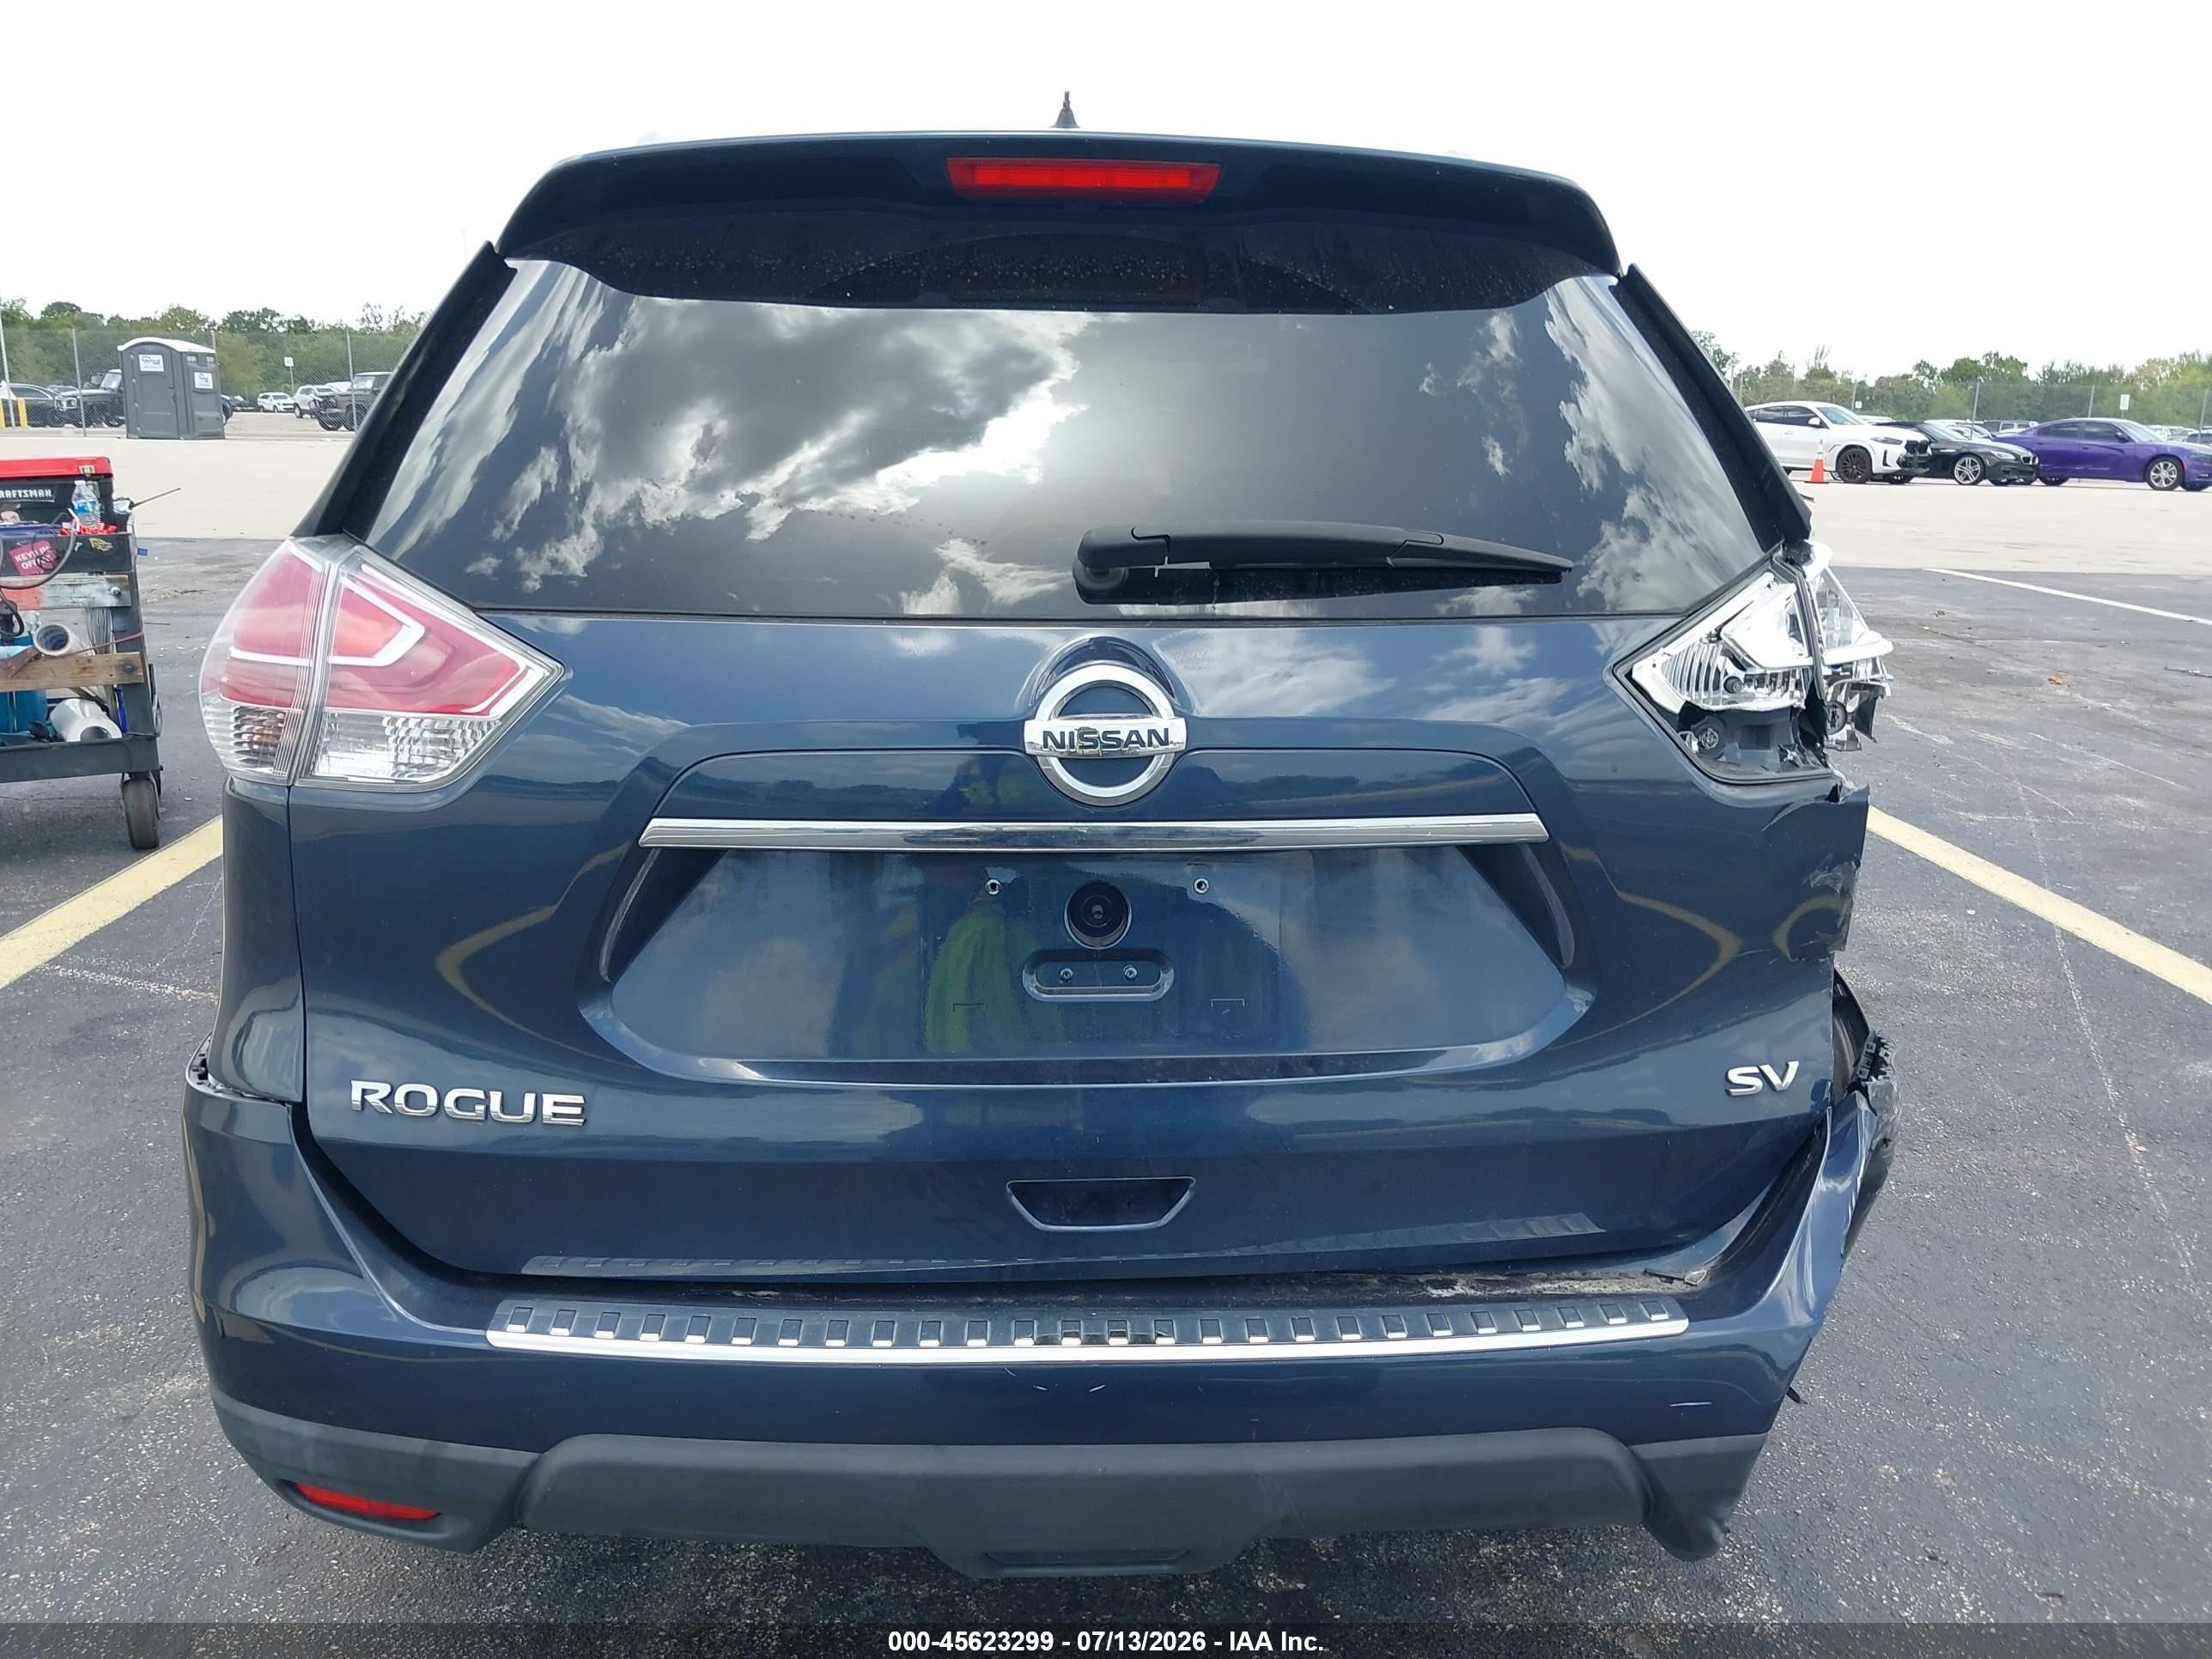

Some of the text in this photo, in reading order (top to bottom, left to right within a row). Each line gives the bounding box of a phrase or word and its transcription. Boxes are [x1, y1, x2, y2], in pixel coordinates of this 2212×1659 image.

[0, 489, 52, 498] RAFTSMAN
[1042, 727, 1170, 750] NISSAN
[1725, 1060, 1799, 1096] SV
[350, 1079, 585, 1127] ROGUE
